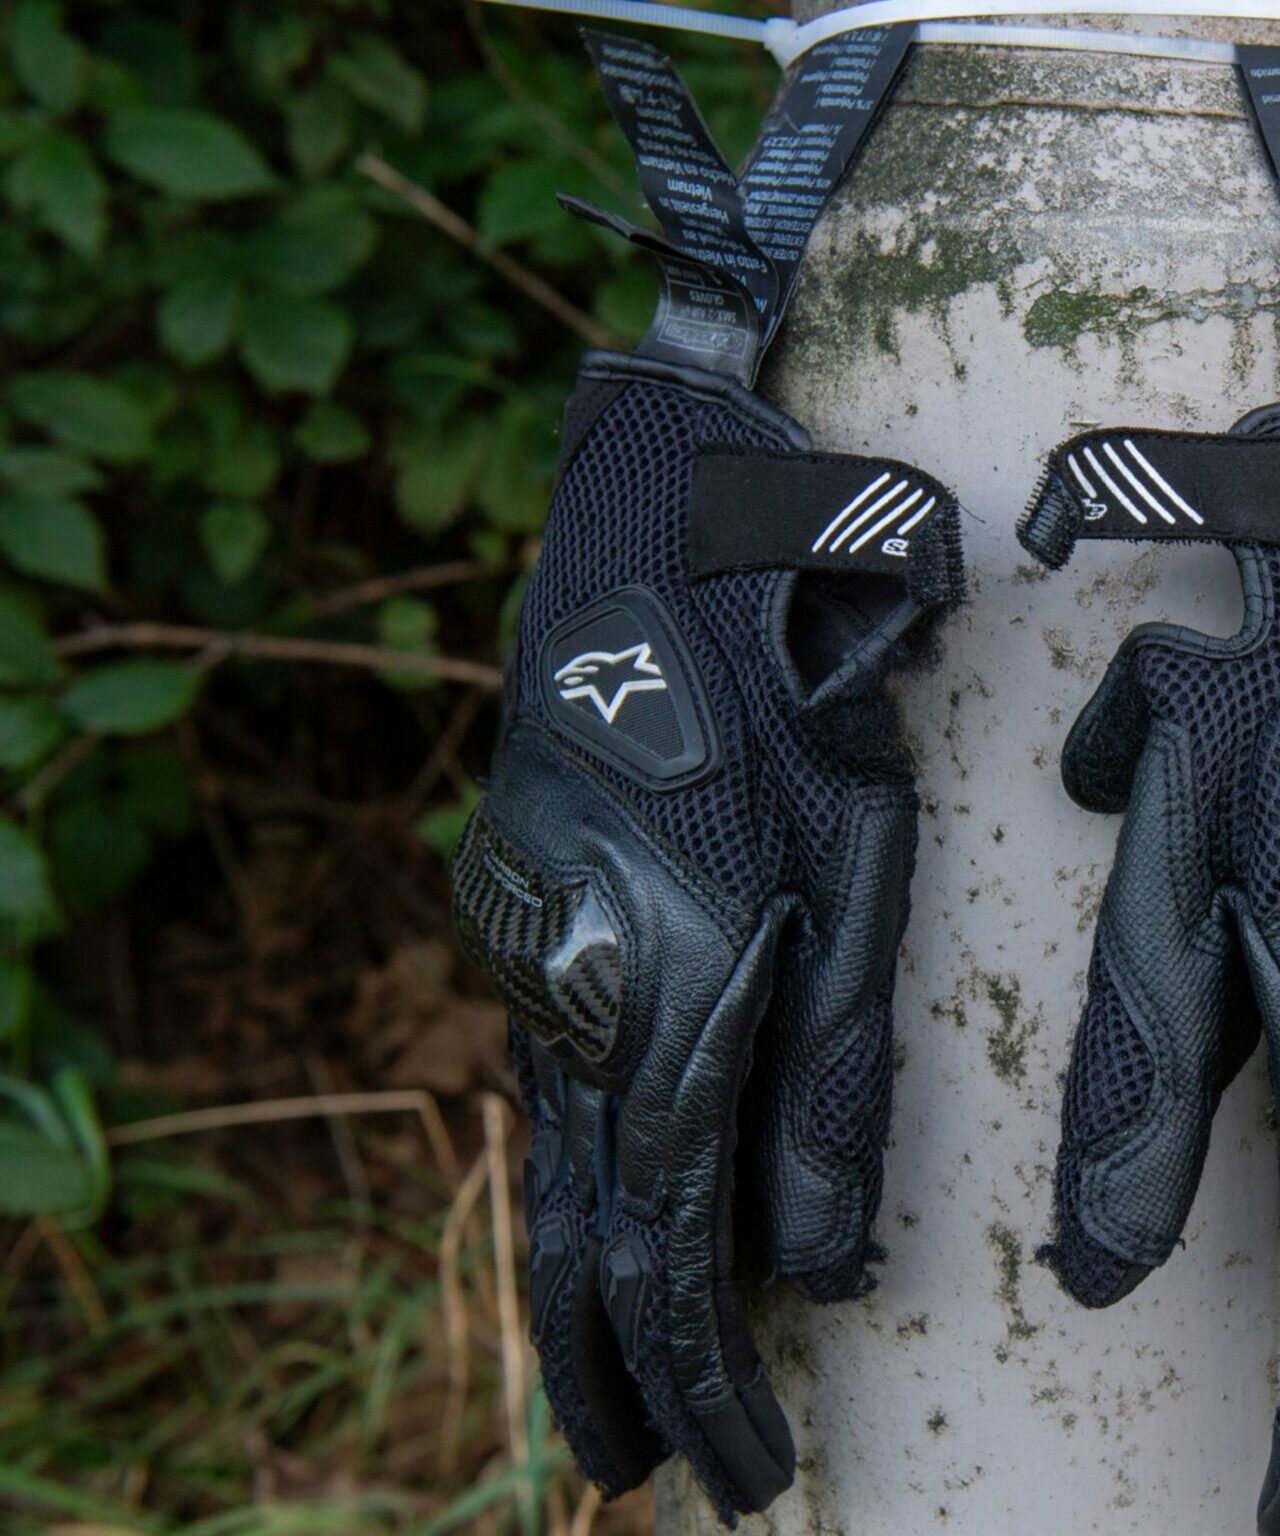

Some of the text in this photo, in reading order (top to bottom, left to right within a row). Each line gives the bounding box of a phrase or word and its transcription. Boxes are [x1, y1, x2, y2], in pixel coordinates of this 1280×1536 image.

[638, 154, 685, 176] Vietnam
[683, 162, 698, 176] en
[667, 178, 713, 202] Vietnam
[724, 254, 737, 268] in
[737, 256, 769, 273] Fatto
[689, 290, 725, 305] GLOVES
